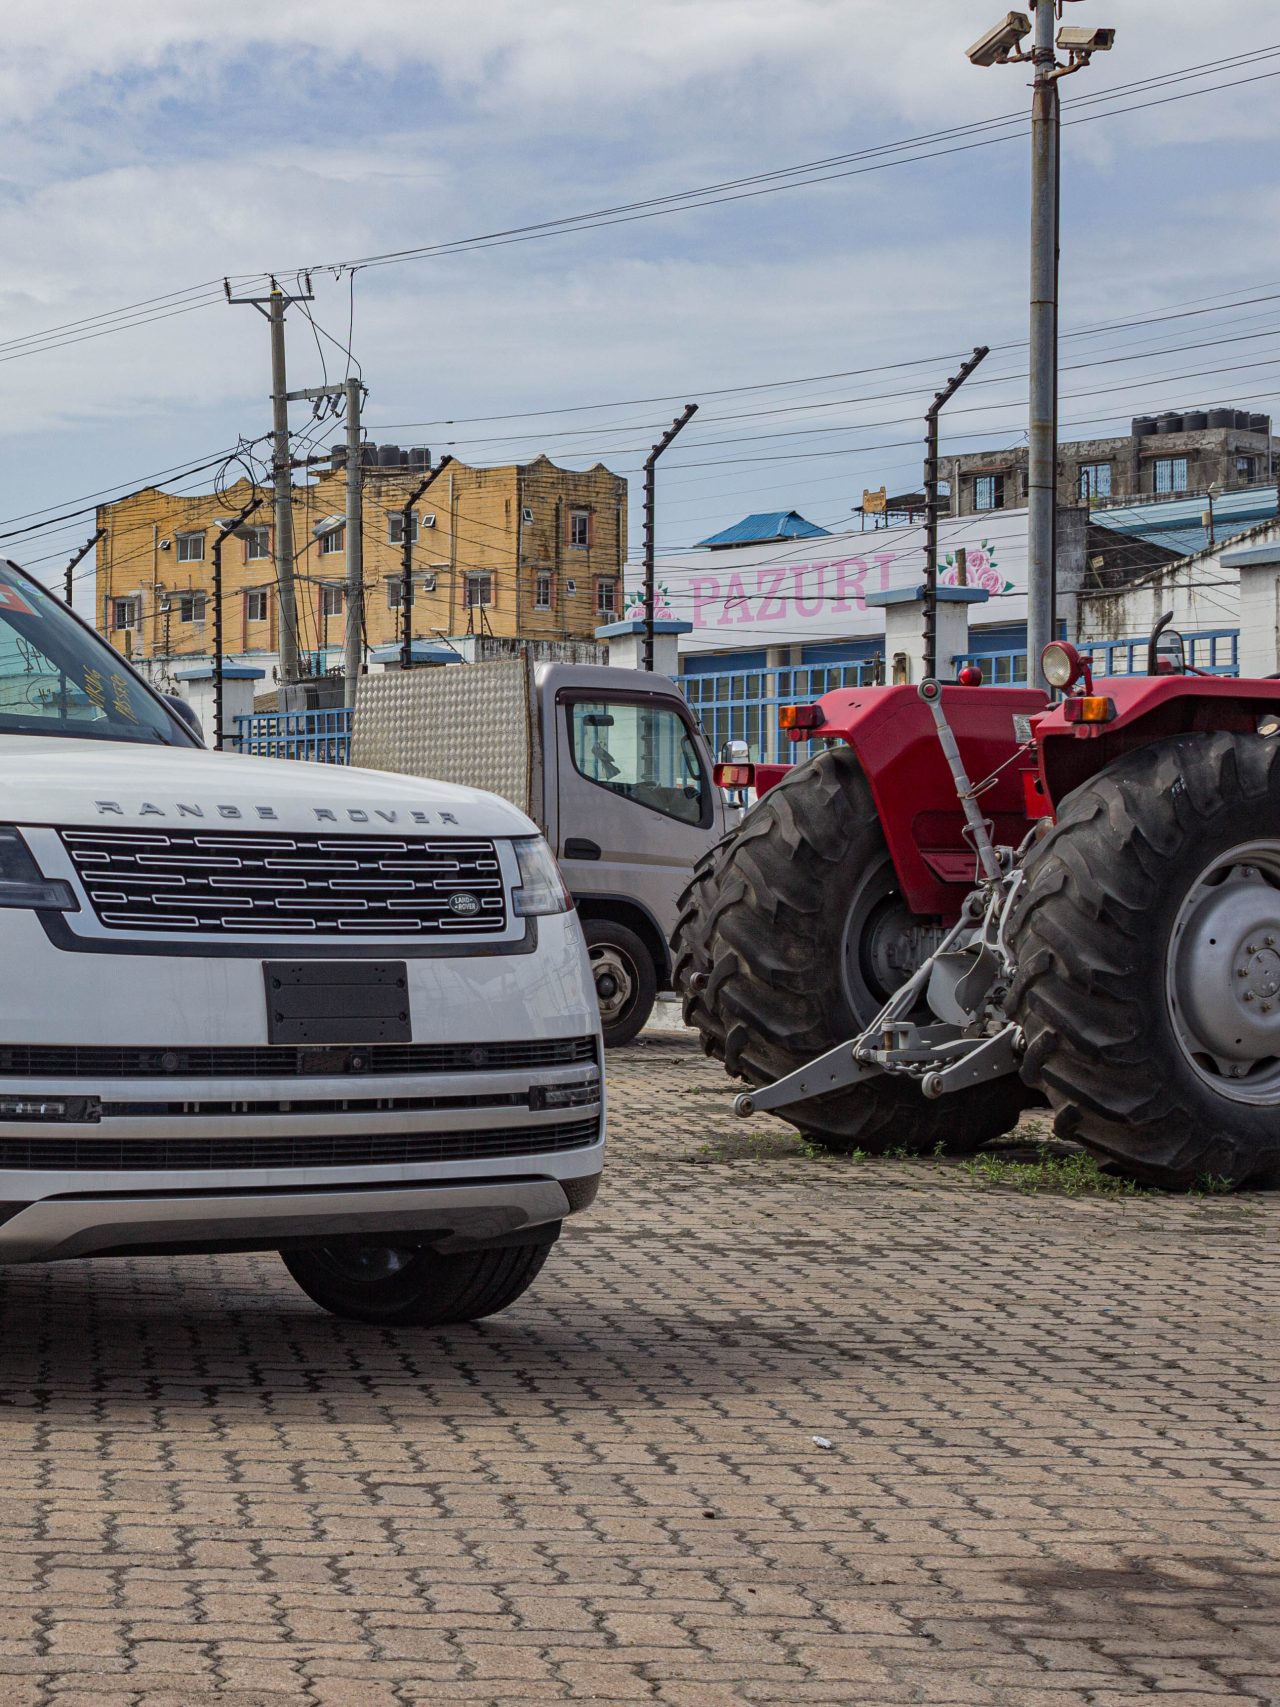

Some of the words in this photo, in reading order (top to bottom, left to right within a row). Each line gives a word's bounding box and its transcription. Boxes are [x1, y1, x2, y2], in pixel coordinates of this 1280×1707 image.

[688, 552, 896, 627] PAZURI
[95, 800, 279, 820] RANGE
[312, 808, 459, 825] ROVER
